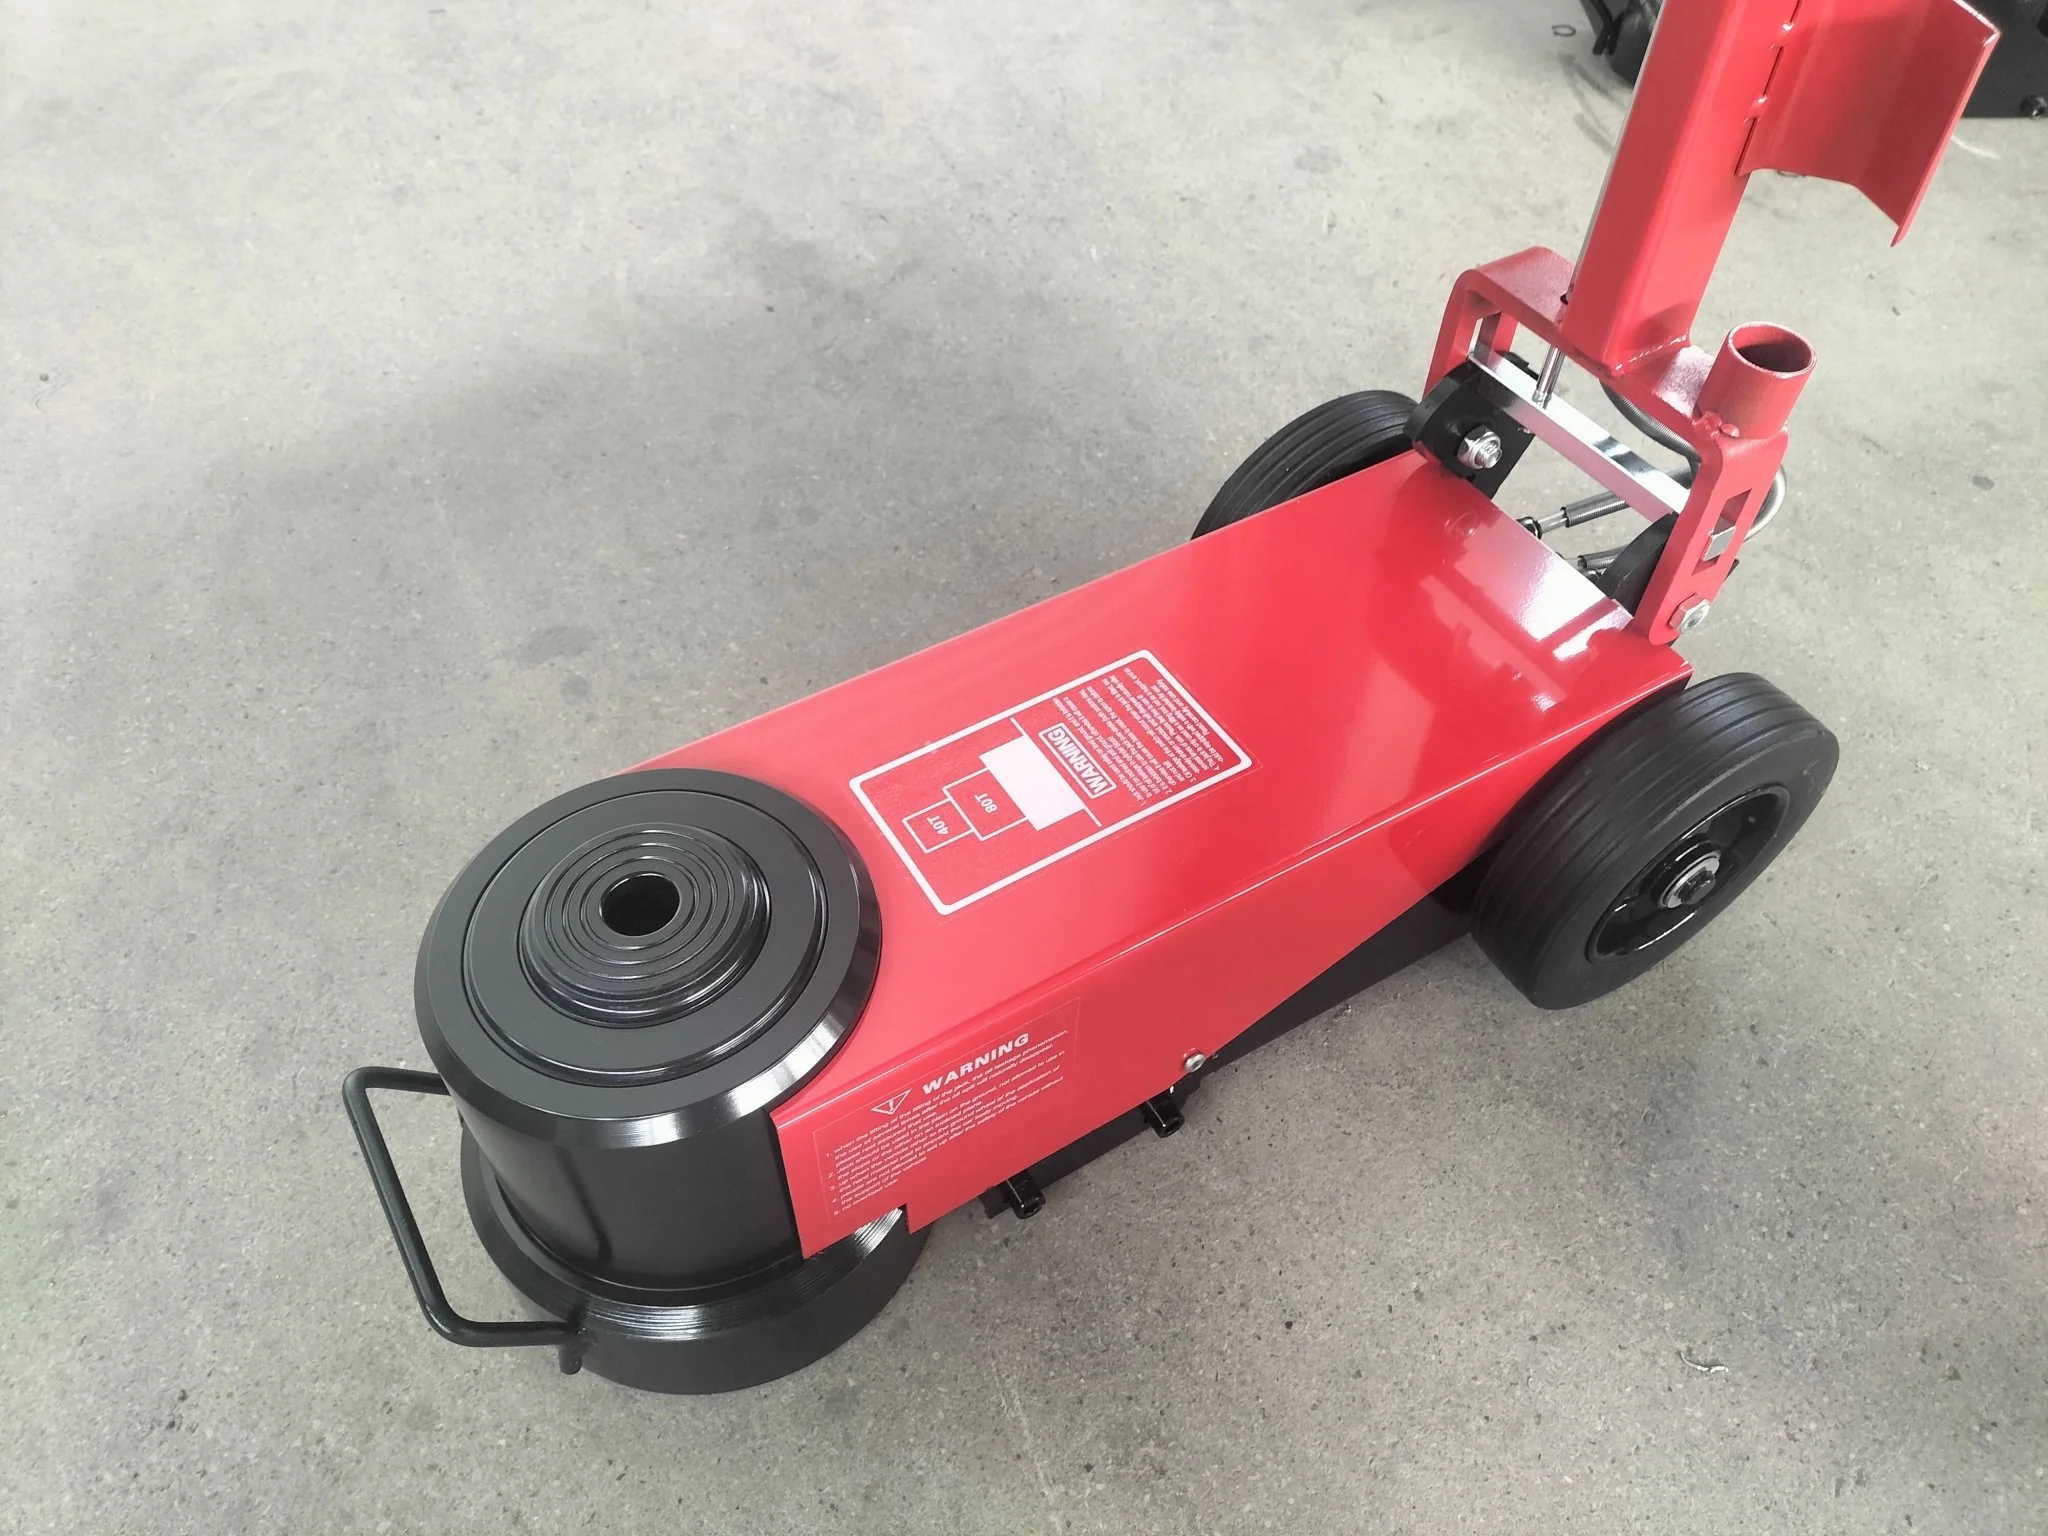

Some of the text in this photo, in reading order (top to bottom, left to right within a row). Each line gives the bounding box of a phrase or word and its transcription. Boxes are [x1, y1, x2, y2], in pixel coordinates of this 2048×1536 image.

[1048, 729, 1106, 792] WARNING
[974, 792, 998, 814] 80T
[926, 814, 950, 836] 40T
[923, 1033, 1028, 1094] WARNING
